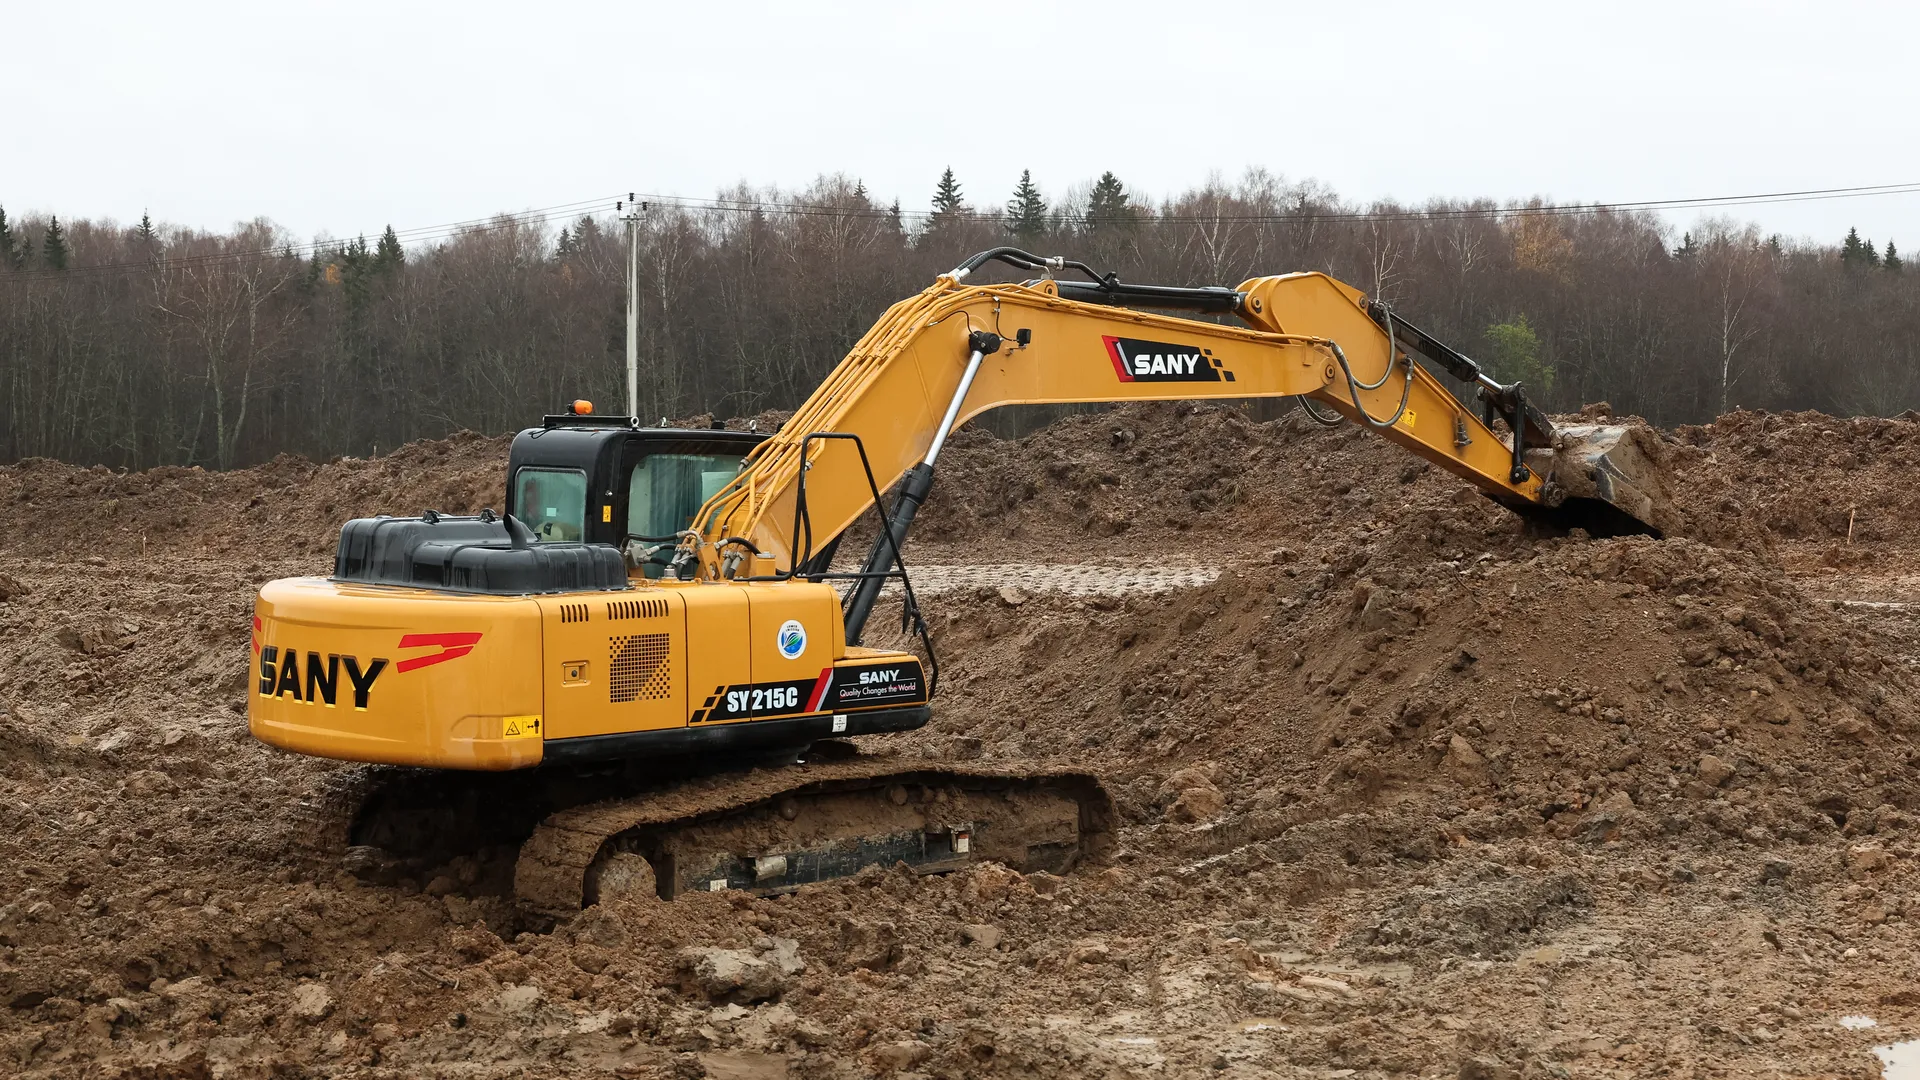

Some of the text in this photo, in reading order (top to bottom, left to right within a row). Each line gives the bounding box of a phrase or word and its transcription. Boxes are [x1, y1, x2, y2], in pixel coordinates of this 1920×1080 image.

[1134, 354, 1200, 375] SANY
[259, 645, 389, 712] SANY
[859, 669, 900, 684] SANY
[840, 682, 916, 698] Quality Changes the World
